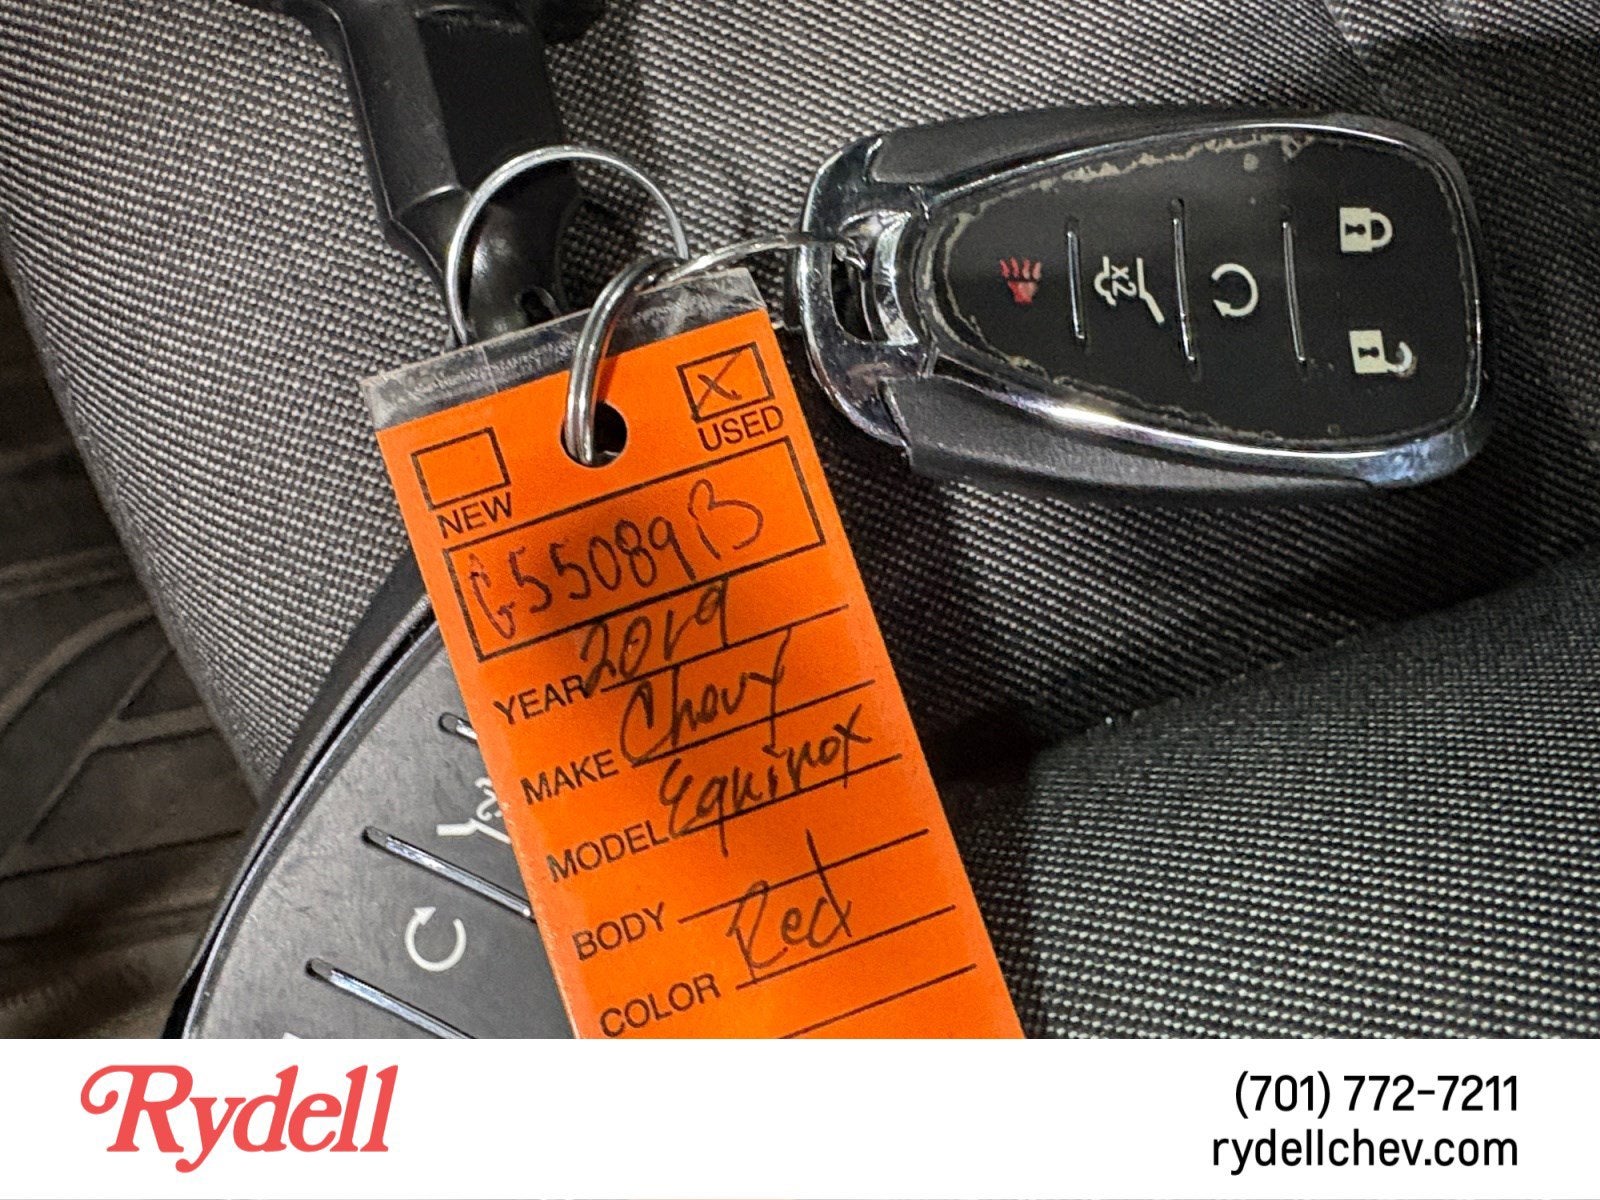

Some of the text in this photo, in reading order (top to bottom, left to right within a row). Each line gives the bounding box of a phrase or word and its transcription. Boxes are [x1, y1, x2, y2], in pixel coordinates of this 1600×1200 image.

[697, 405, 784, 452] USED
[437, 492, 512, 539] NEW
[579, 577, 730, 698] 2019
[494, 674, 589, 725] YEAR
[520, 750, 618, 805] MAKE
[660, 704, 872, 857] Equinox
[547, 819, 671, 882] MODEL
[572, 902, 666, 961] BODY
[727, 828, 852, 983] Red
[600, 972, 721, 1037] COLOR
